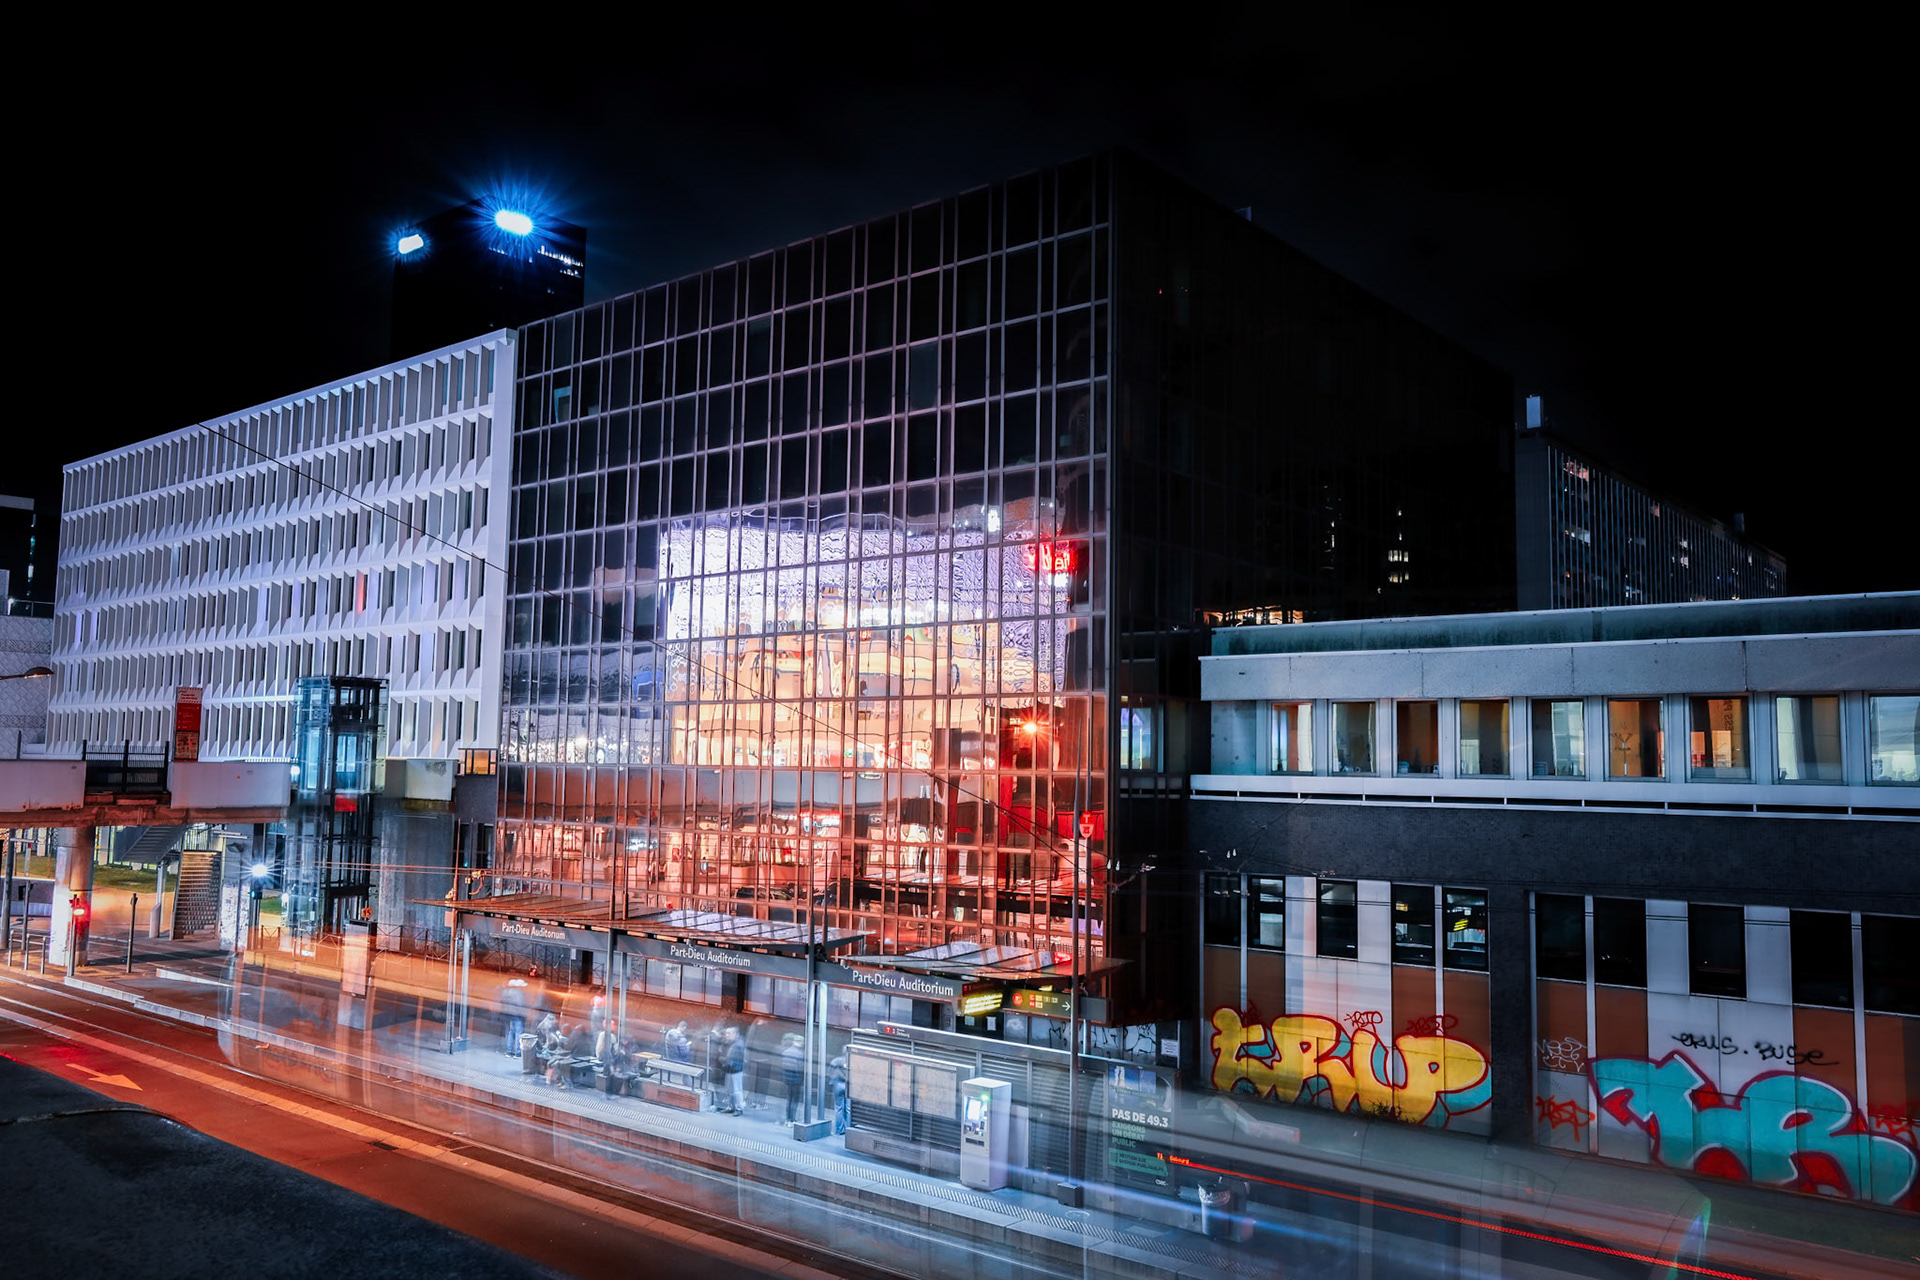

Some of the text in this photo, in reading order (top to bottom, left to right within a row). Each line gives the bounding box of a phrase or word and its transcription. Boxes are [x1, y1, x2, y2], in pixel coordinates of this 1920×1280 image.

[501, 922, 566, 940] Part-Dieu Auditorium
[670, 945, 751, 967] Part-Dieu Auditorium
[852, 970, 954, 997] Part-Dieu Auditorium
[1111, 1108, 1169, 1128] PAS DE 49.3
[1111, 1121, 1146, 1134] EXIGEONS
[1111, 1128, 1123, 1137] UN
[1111, 1136, 1137, 1148] PUBLIC
